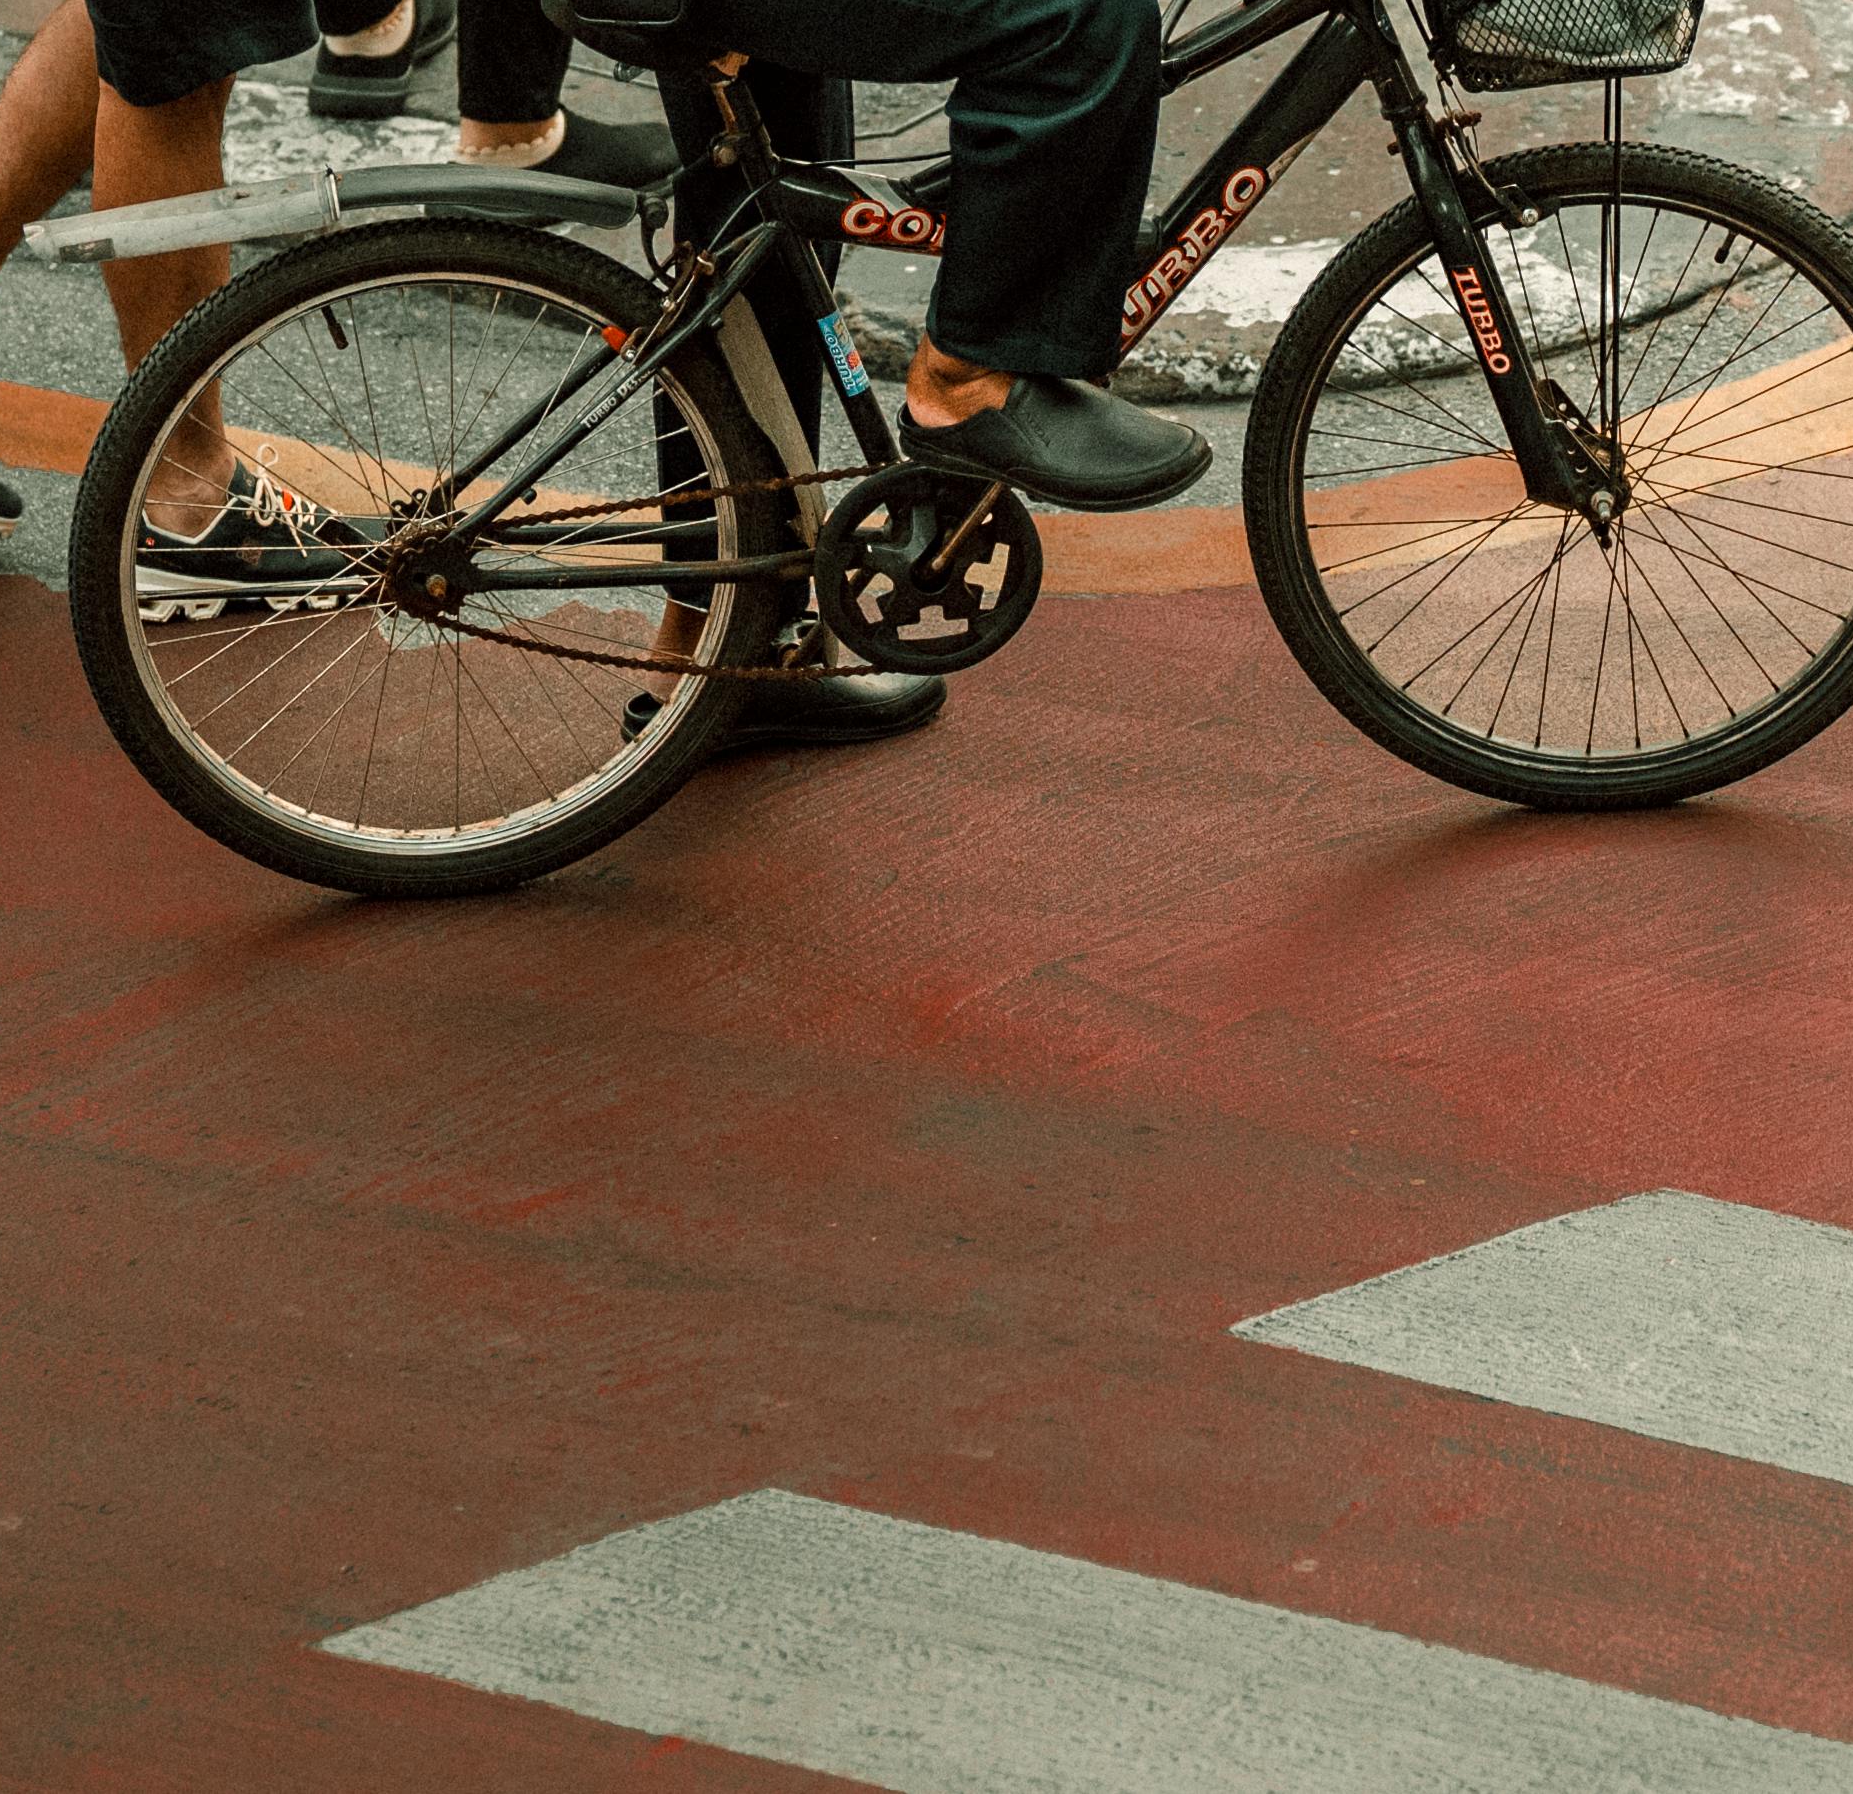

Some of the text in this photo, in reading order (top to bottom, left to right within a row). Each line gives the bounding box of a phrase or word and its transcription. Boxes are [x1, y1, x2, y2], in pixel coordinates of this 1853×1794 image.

[1122, 165, 1267, 346] URBO
[823, 331, 857, 393] TURBO
[1451, 265, 1512, 375] TURBO
[579, 392, 617, 429] TURBO
